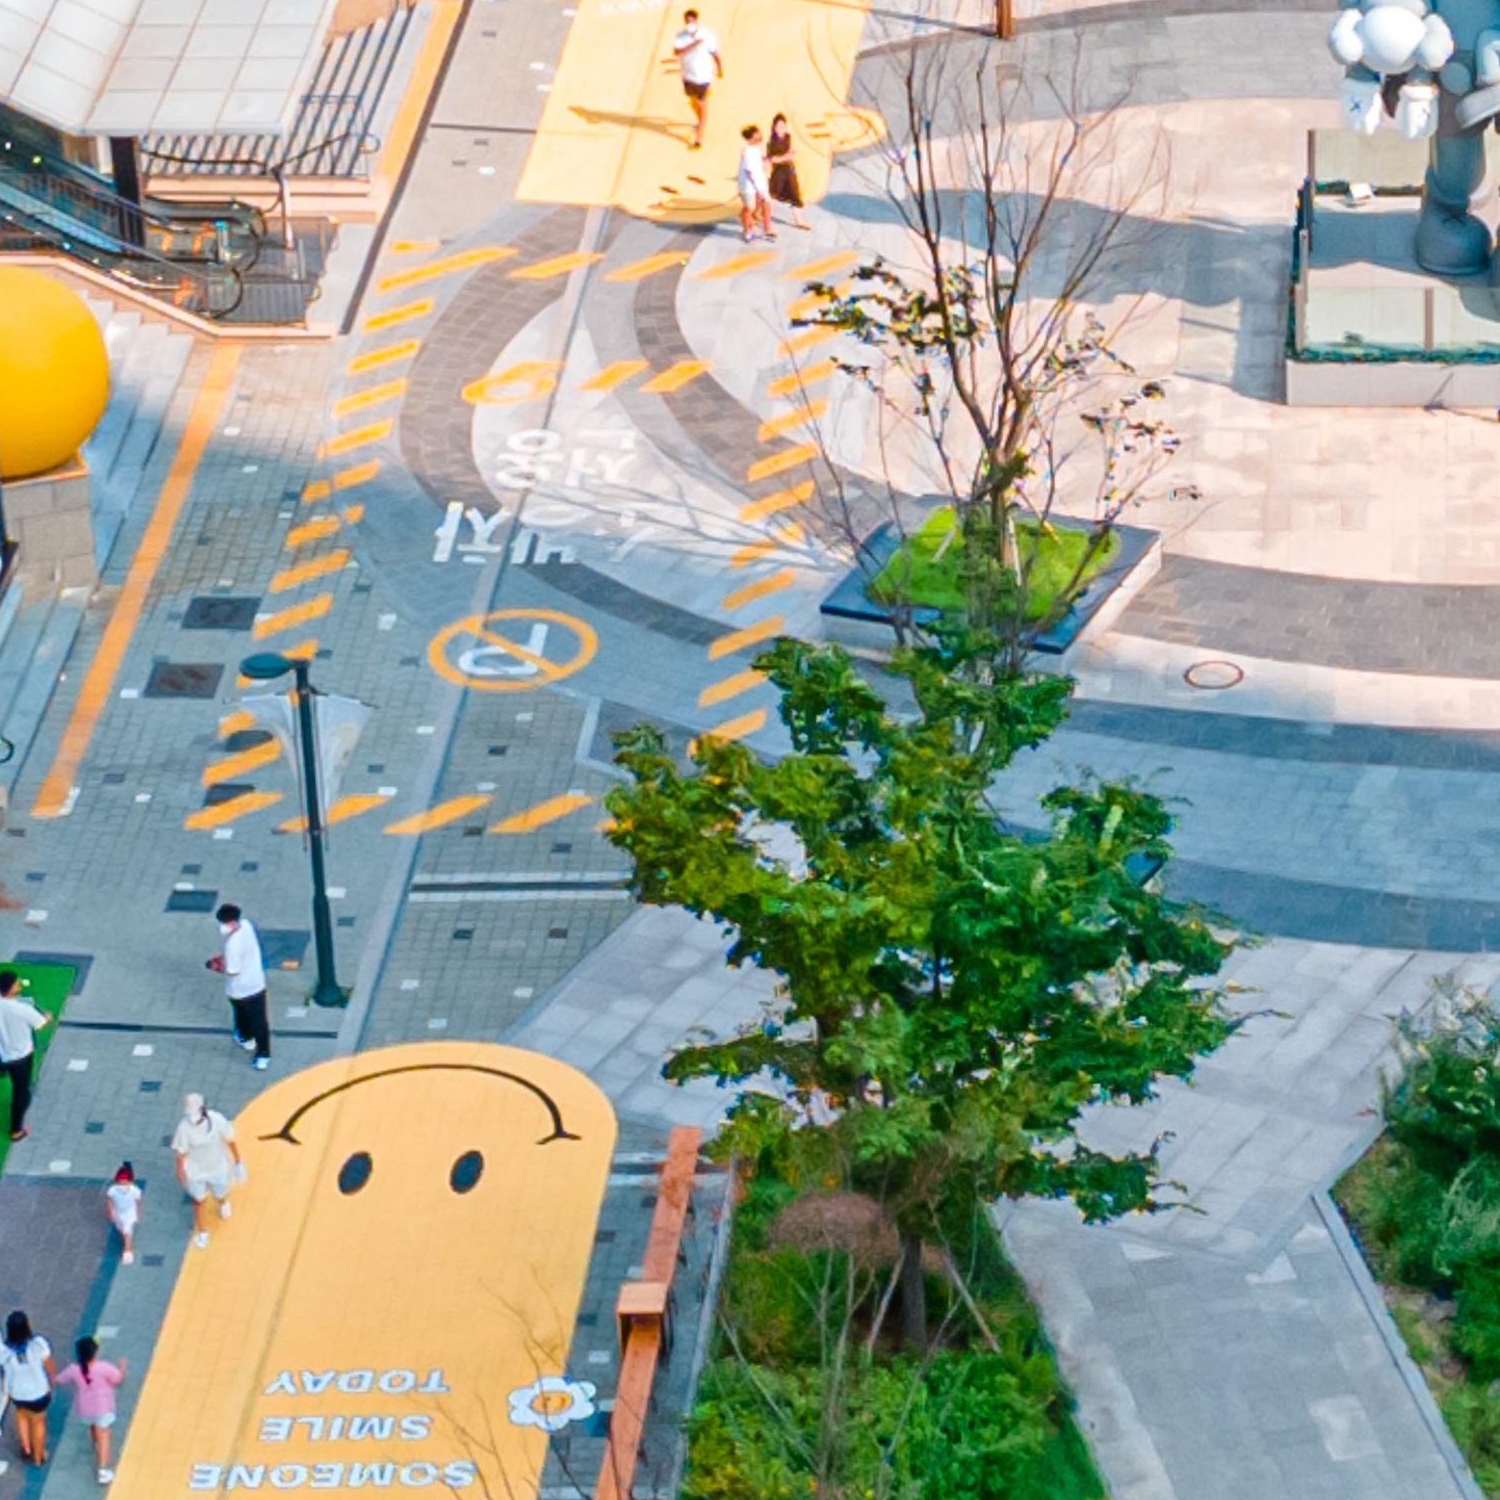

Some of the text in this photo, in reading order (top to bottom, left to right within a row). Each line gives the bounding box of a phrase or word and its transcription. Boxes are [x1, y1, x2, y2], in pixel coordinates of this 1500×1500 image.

[494, 427, 638, 490] 전용
[432, 501, 654, 565] 소방차
[264, 1369, 453, 1397] TODAY
[258, 1414, 434, 1443] SMILE
[188, 1460, 478, 1490] SOMEONE
